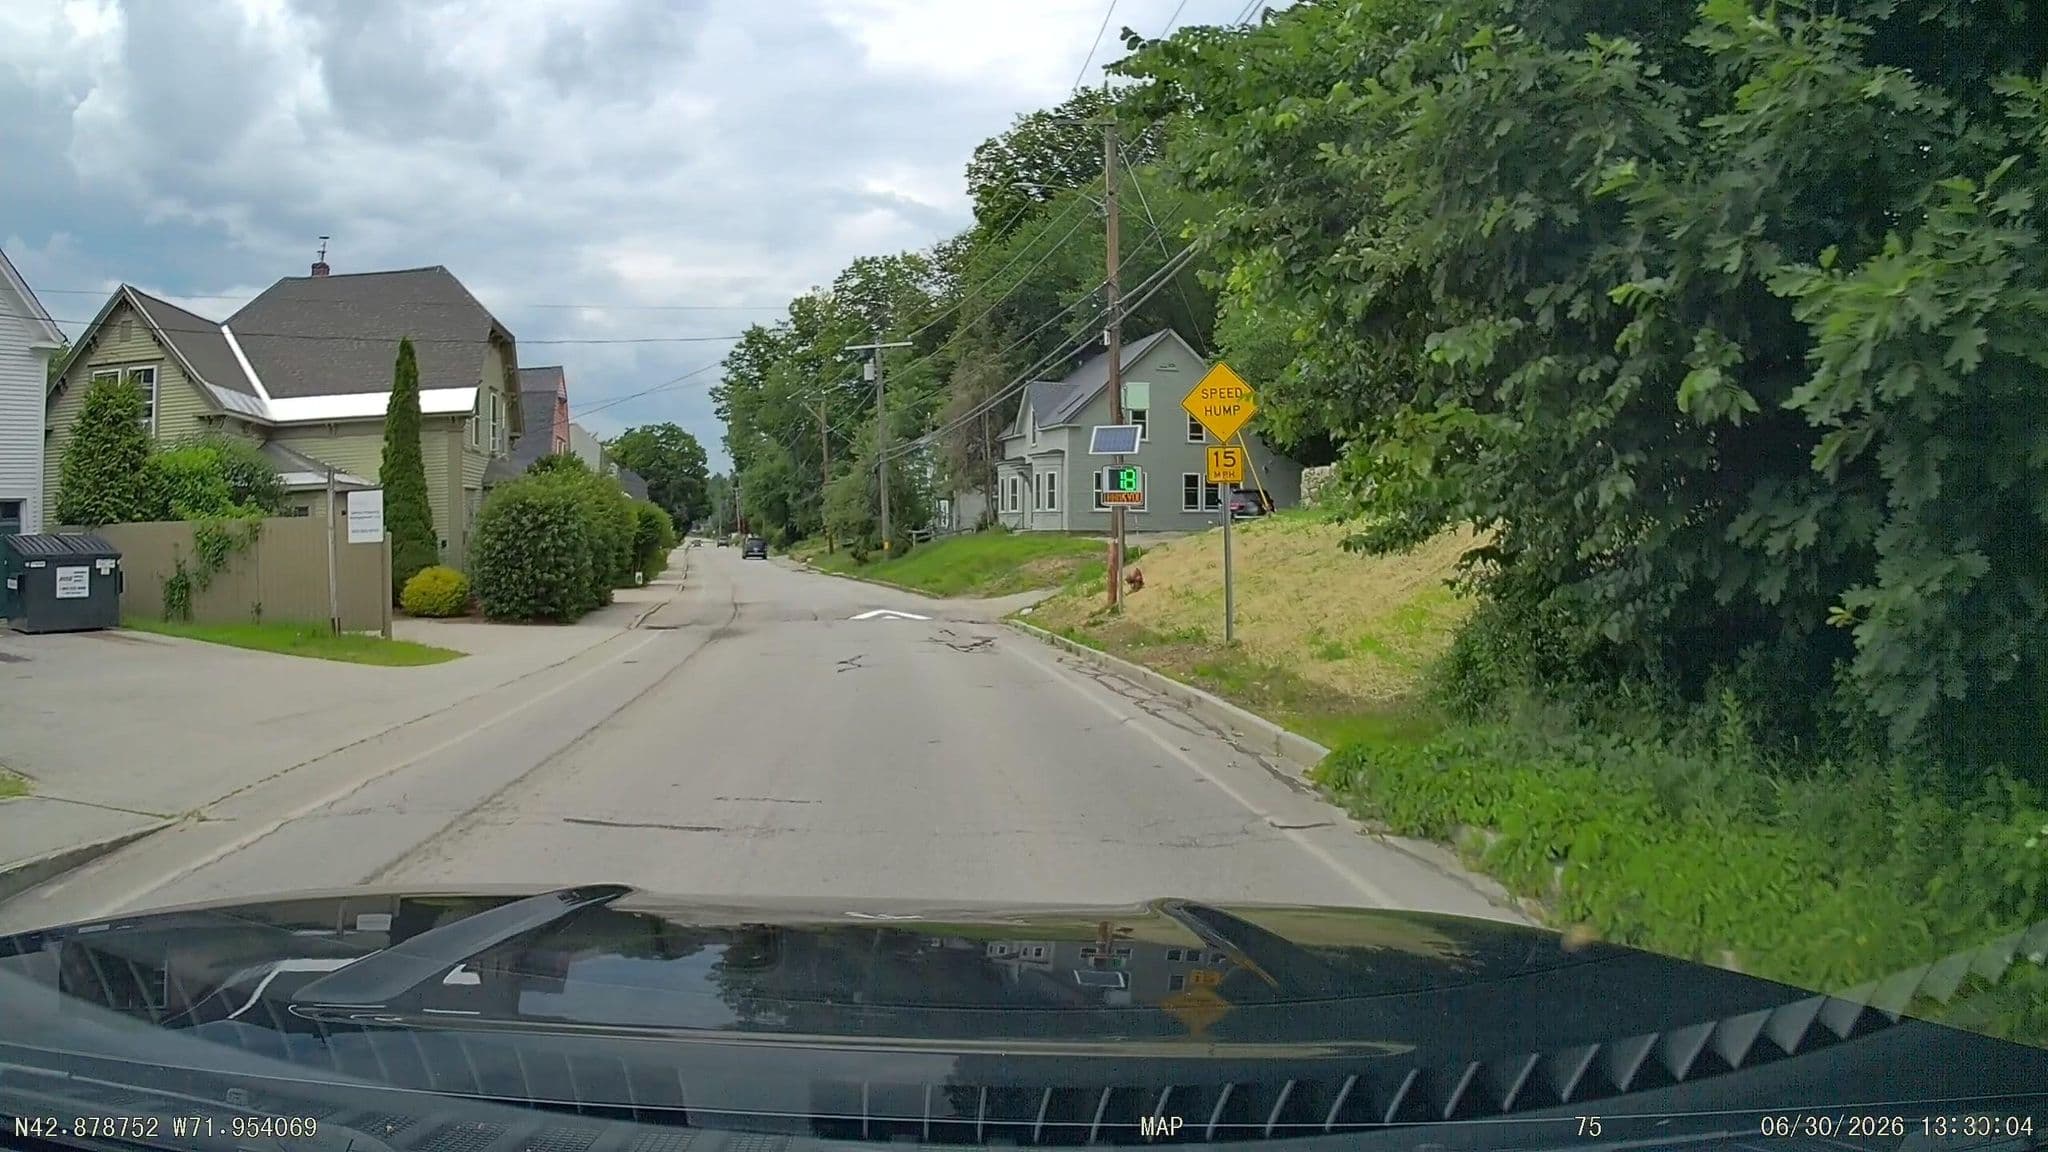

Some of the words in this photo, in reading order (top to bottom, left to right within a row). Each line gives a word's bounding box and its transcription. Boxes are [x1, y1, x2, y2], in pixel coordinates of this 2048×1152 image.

[1201, 387, 1243, 399] SPEED
[1204, 404, 1241, 416] HUMP
[1214, 450, 1236, 467] 15
[1119, 468, 1136, 491] 18
